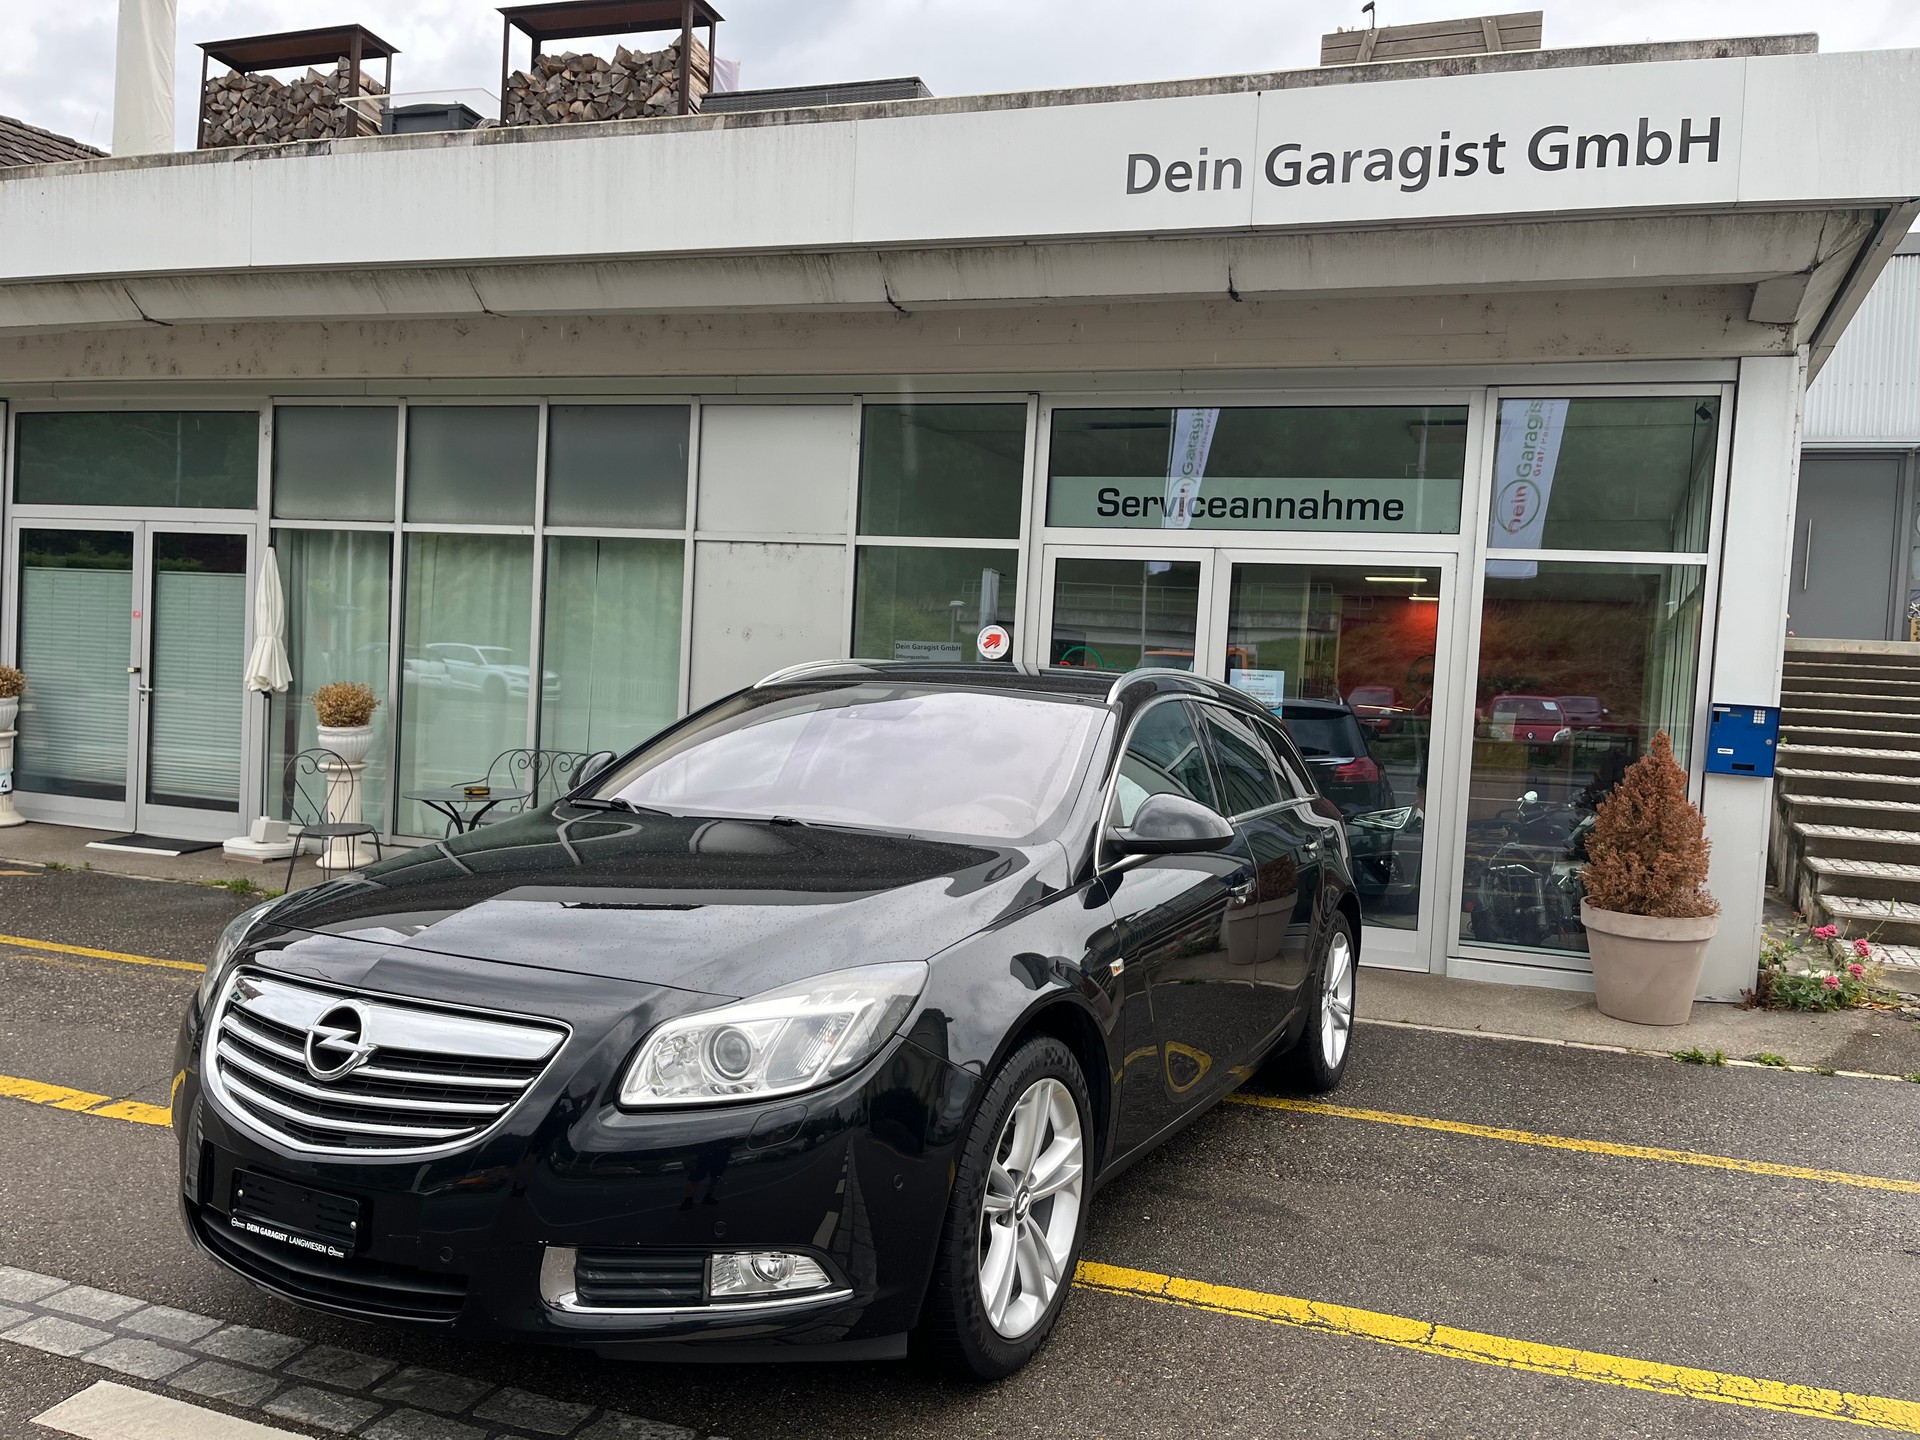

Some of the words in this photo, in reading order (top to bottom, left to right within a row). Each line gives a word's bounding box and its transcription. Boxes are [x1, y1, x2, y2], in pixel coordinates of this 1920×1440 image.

[1126, 147, 1243, 195] Dein
[1264, 131, 1507, 193] Garagist
[1526, 116, 1721, 171] GmbH
[1096, 487, 1405, 521] Serviceannahme
[912, 643, 939, 652] Garagist
[940, 644, 961, 652] GmbH
[983, 1062, 1034, 1156] PremiumContact
[246, 1222, 260, 1233] DEIN
[259, 1227, 288, 1241] GARAGIST
[289, 1235, 327, 1253] LANGWIESEN
